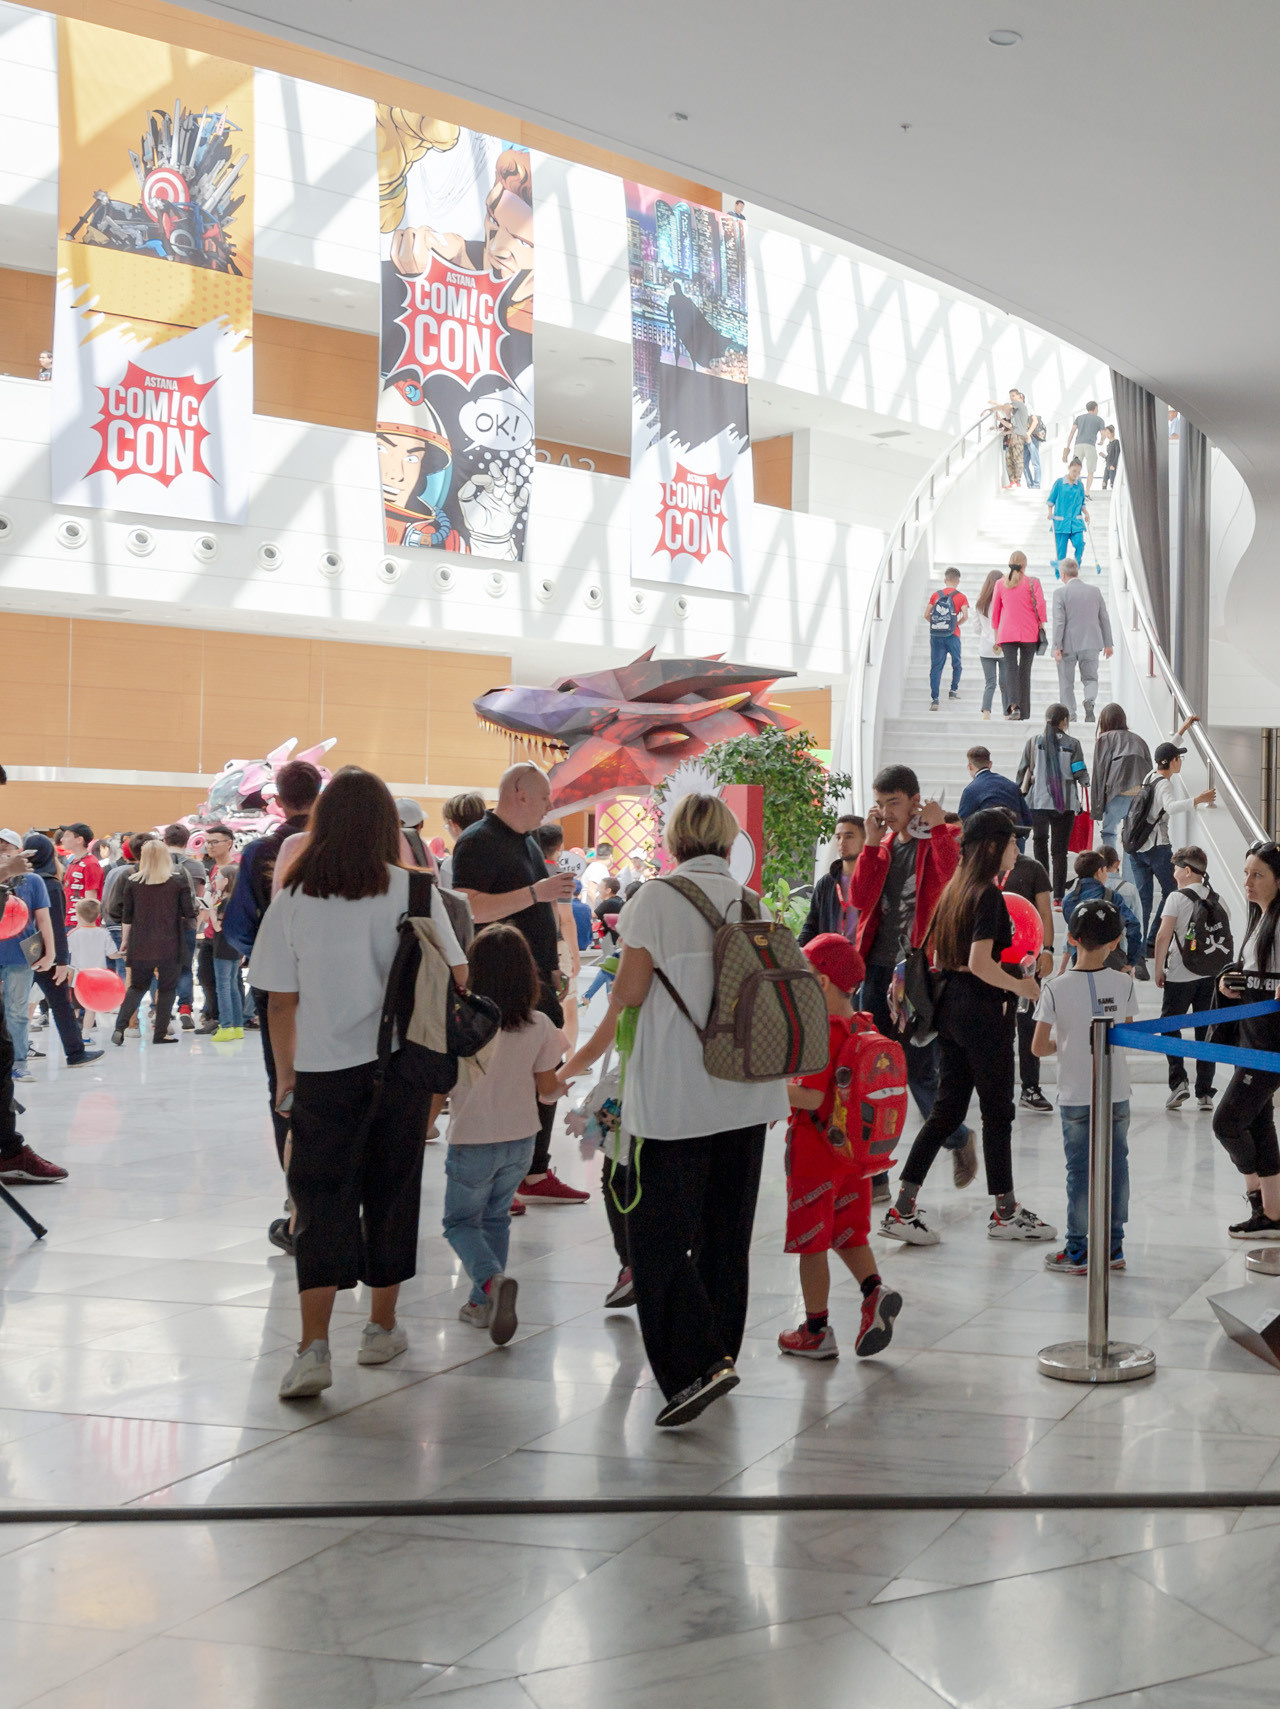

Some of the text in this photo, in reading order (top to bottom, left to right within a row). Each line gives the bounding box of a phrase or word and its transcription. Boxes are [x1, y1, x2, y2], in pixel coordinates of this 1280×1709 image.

[446, 271, 476, 288] ASTANA
[414, 314, 491, 374] CON
[145, 376, 178, 391] ASTANA
[475, 412, 520, 441] OK!
[107, 419, 194, 476] CON
[665, 508, 718, 554] CON
